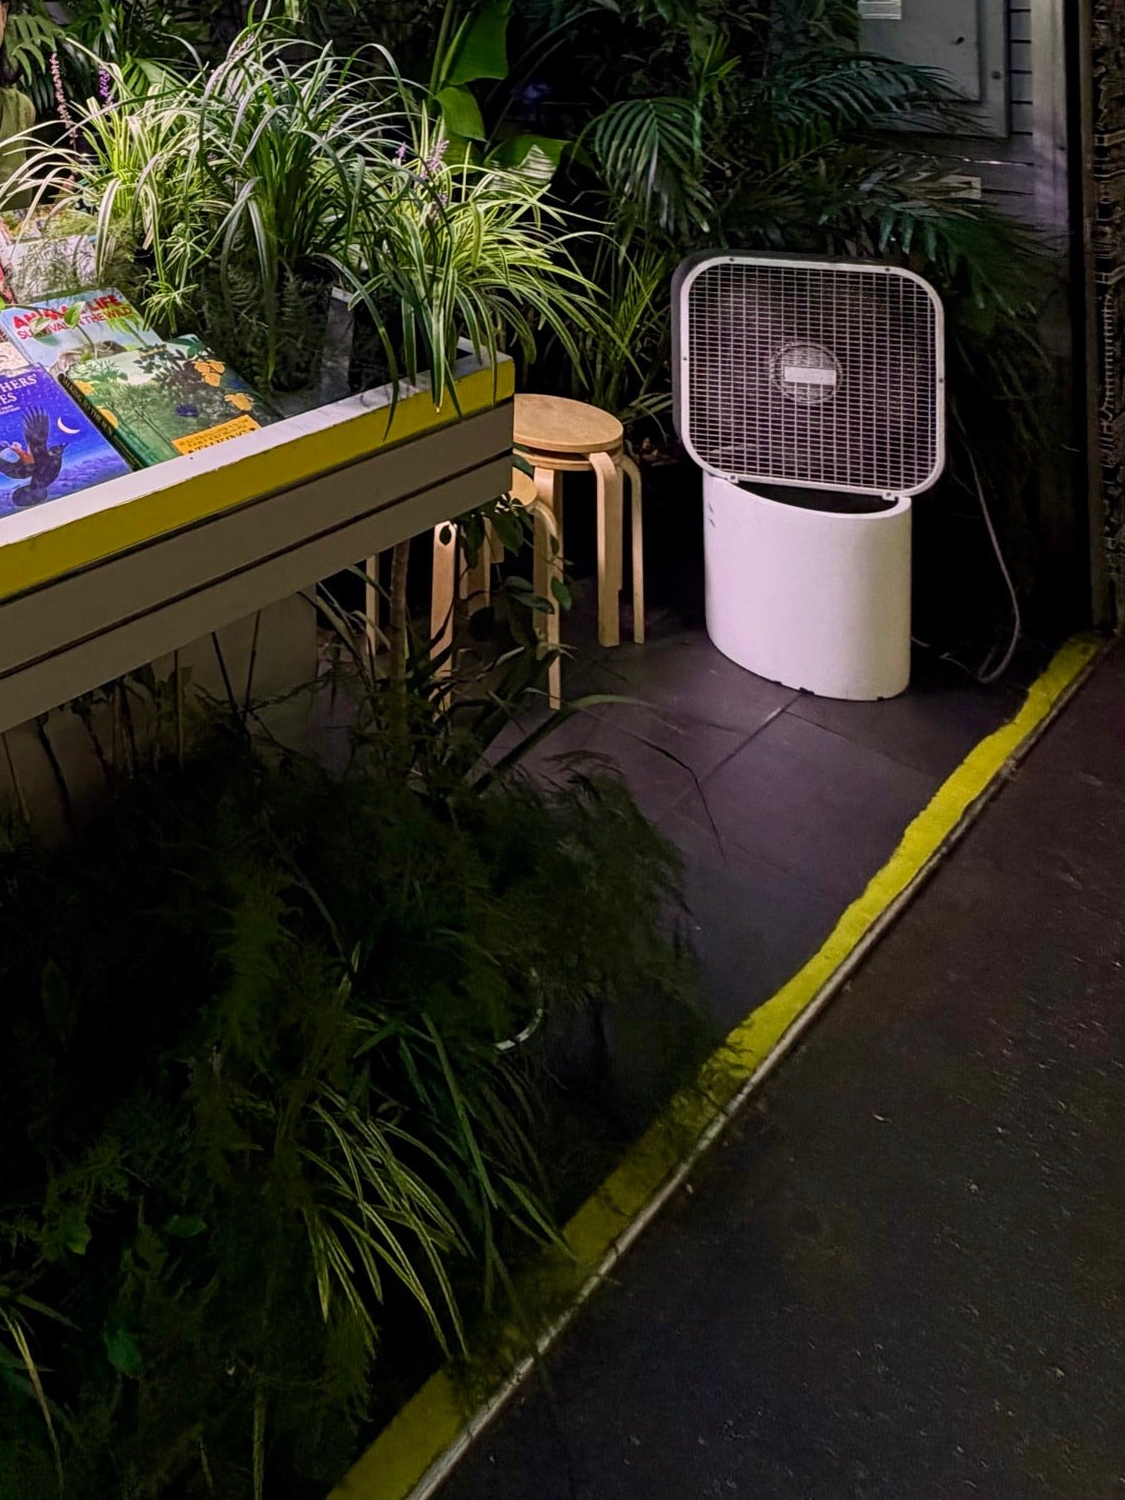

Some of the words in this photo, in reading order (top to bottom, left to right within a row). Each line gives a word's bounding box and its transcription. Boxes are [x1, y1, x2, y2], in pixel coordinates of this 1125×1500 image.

[13, 304, 80, 329] ANIMA
[87, 294, 122, 312] LIFE
[83, 312, 105, 324] THE
[104, 306, 133, 320] WILD
